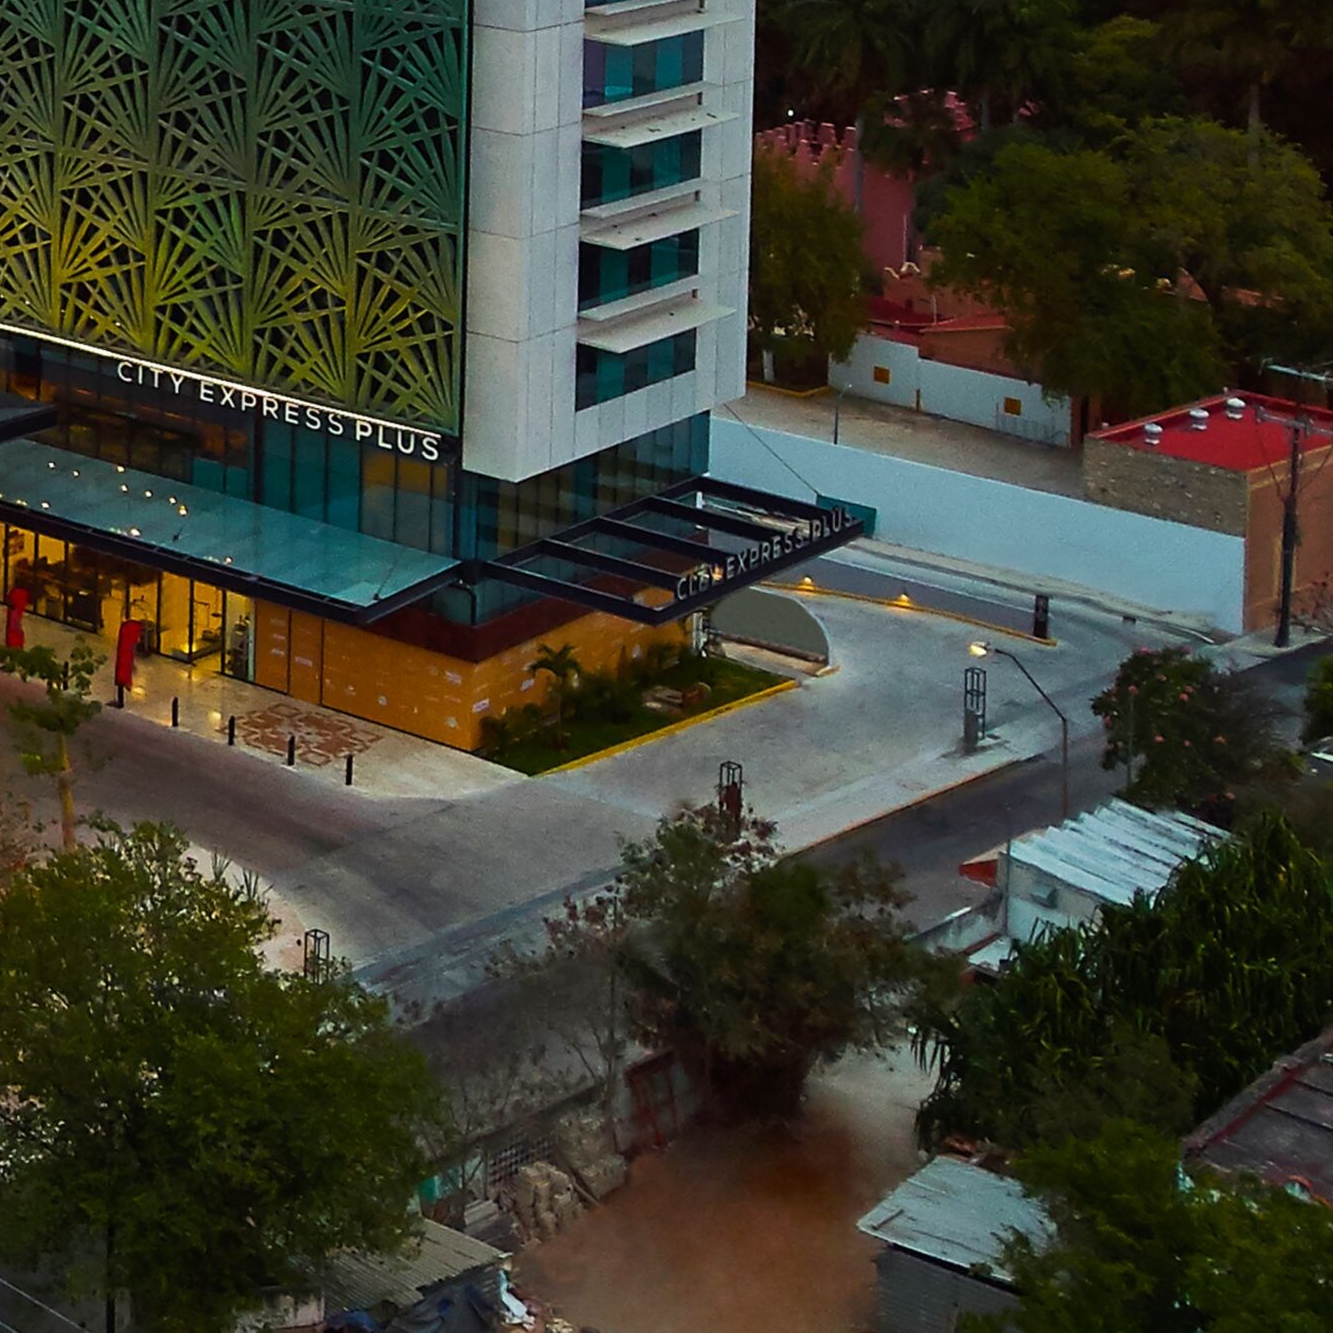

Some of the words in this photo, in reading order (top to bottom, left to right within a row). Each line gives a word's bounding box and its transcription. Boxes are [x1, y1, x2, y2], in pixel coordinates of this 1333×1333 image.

[118, 361, 185, 395] CITY
[199, 382, 344, 436] EXPRESS
[356, 421, 440, 461] PLUS
[726, 533, 808, 579] EXPRESS
